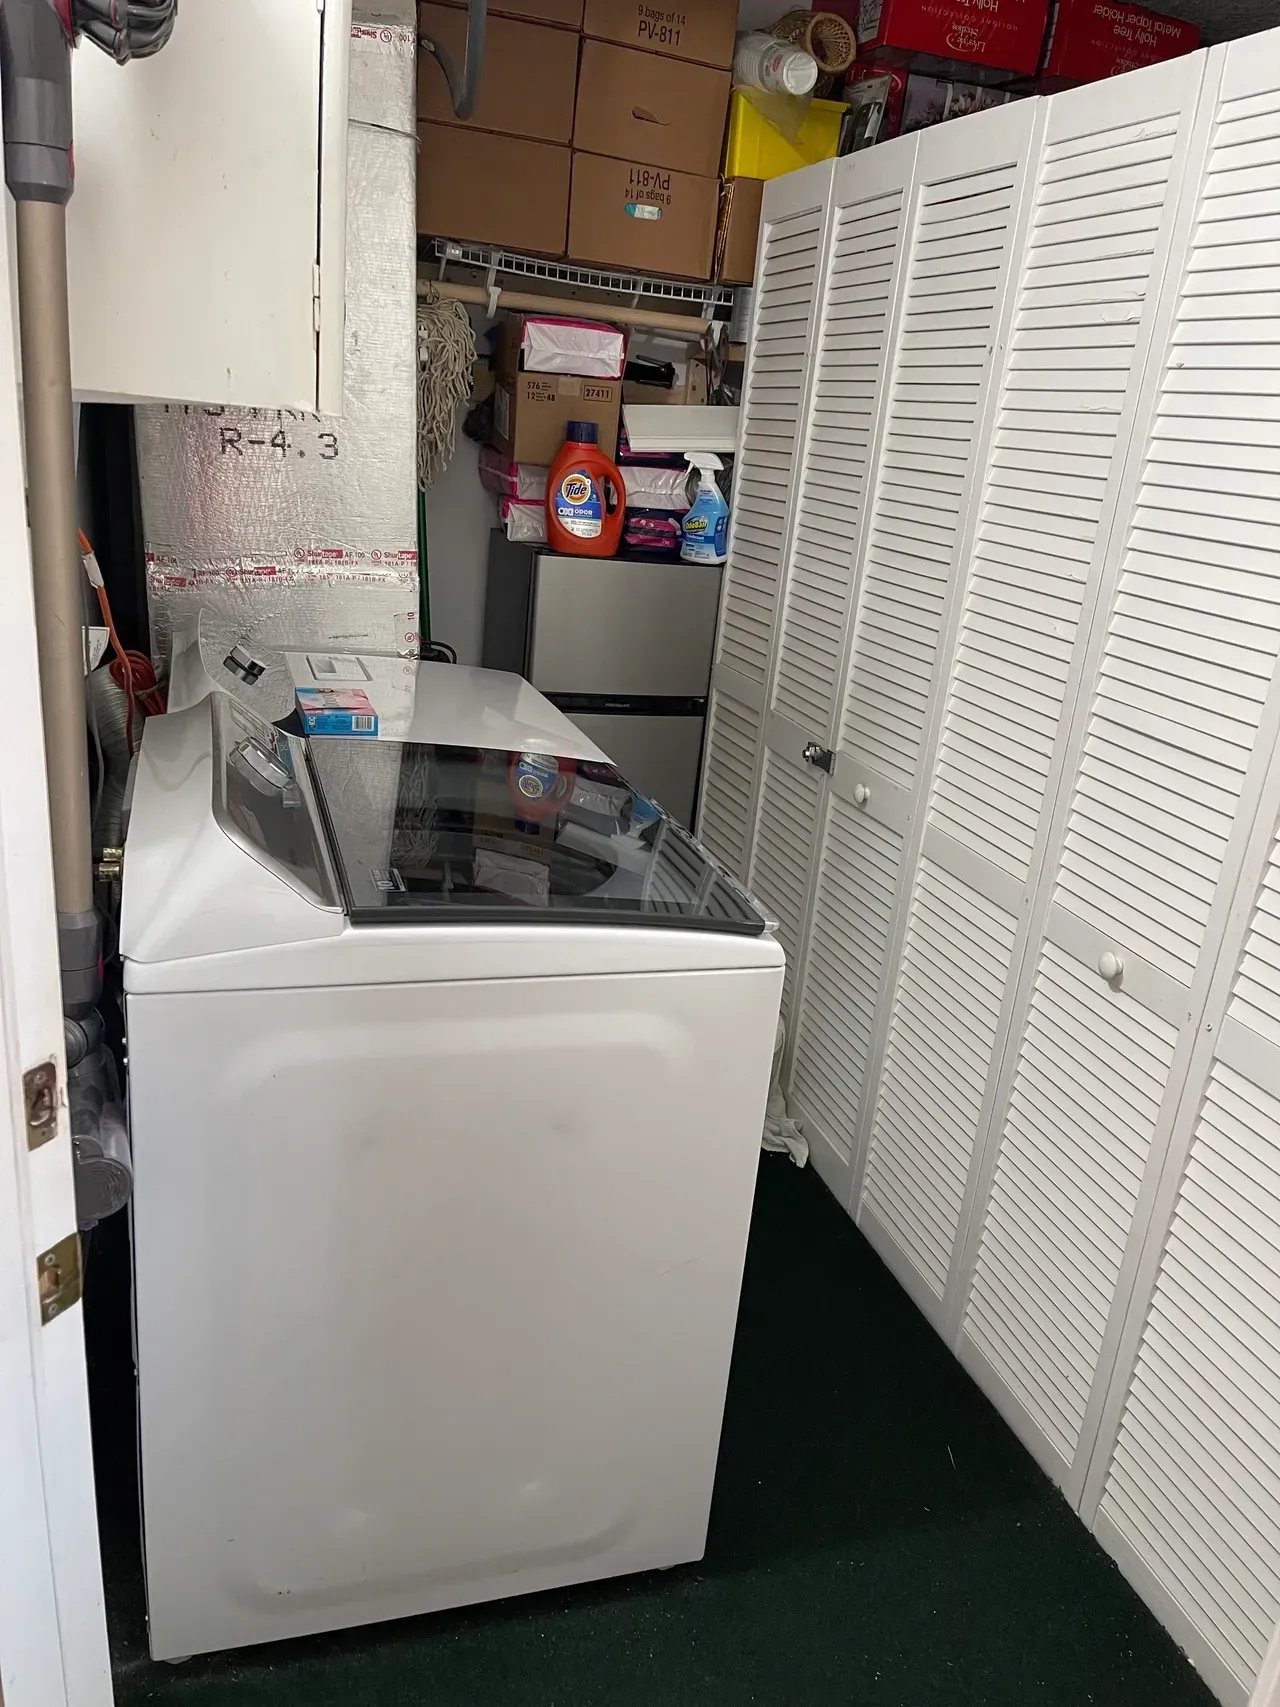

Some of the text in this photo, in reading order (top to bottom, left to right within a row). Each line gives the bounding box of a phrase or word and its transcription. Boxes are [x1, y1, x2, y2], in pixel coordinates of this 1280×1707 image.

[638, 4, 686, 26] 9 bags of 14
[1092, 4, 1181, 38] Metal Taper Holder
[638, 20, 681, 46] PV-811
[1113, 24, 1157, 48] Holly Tree
[629, 168, 671, 191] PV-811
[624, 188, 672, 205] 9 bags of 14
[527, 382, 541, 390] 576
[586, 388, 610, 399] 27411
[527, 392, 536, 400] 12
[546, 393, 556, 402] 48
[566, 482, 588, 498] Tide
